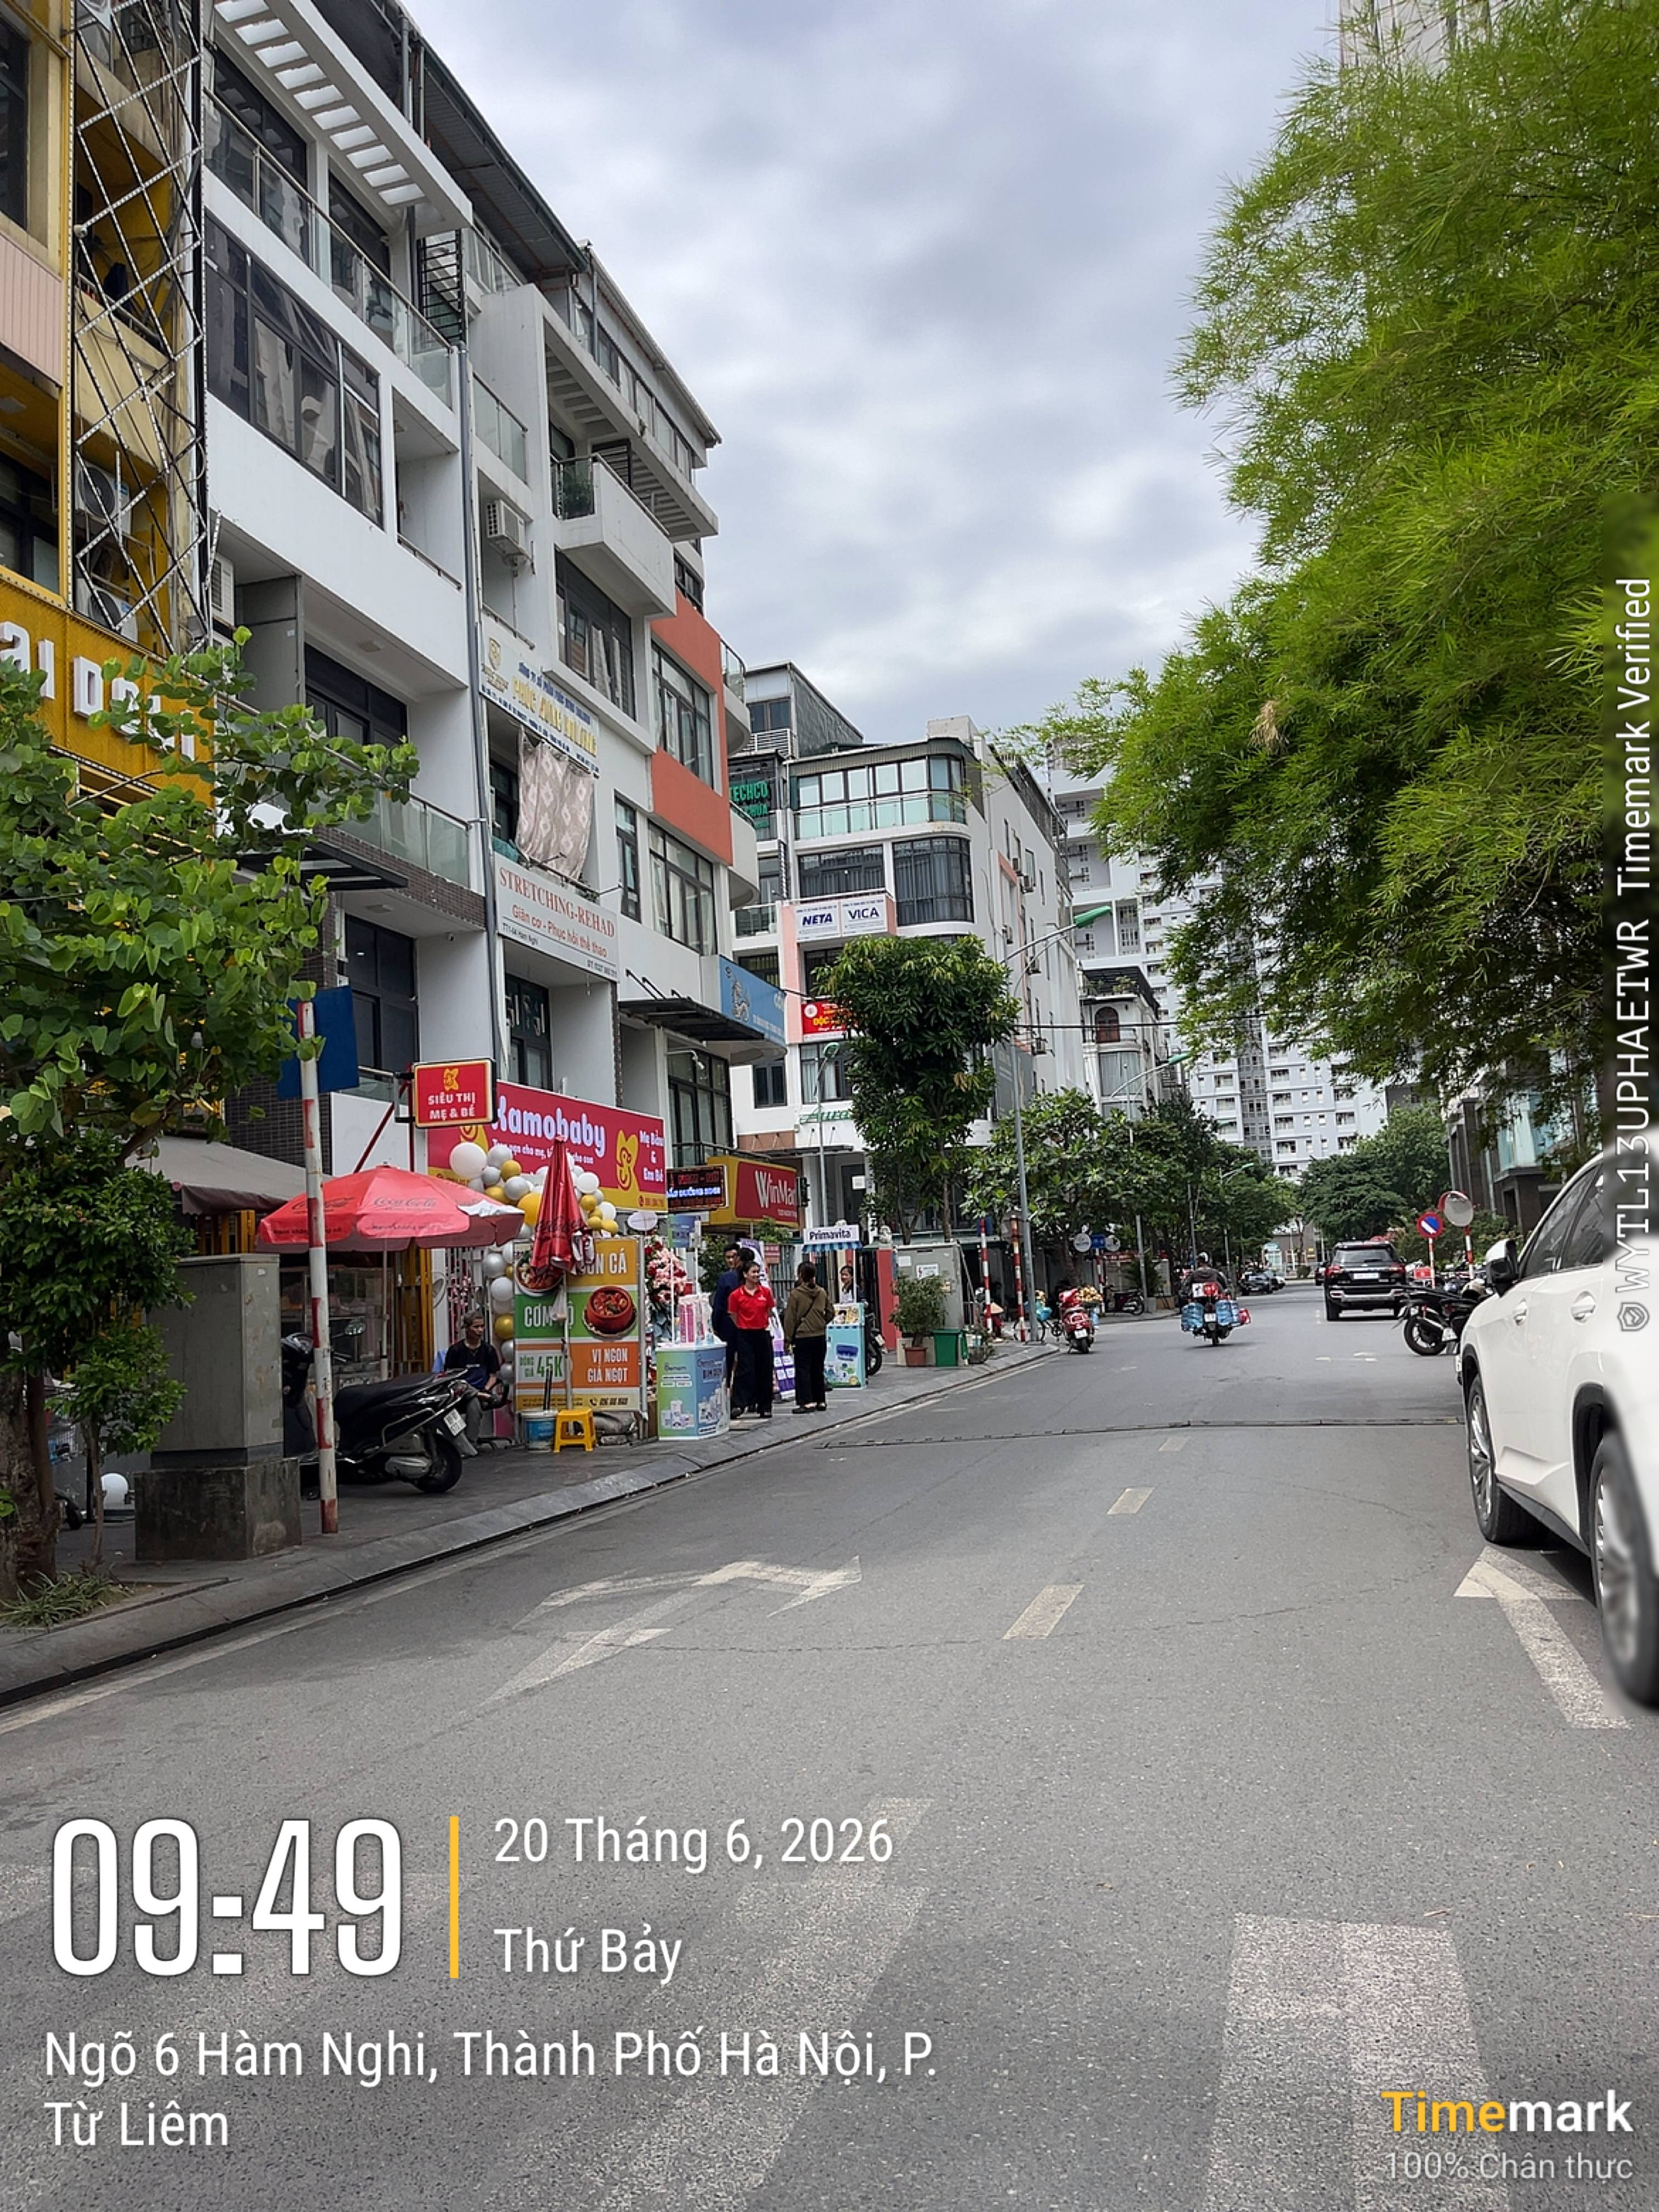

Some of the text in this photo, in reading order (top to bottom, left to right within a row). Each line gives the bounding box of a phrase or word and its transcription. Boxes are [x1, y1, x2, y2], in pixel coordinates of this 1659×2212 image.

[802, 913, 833, 927] NETA
[848, 907, 879, 919] VICA
[428, 1091, 476, 1105] SIÊU THỊ
[429, 1104, 476, 1121] MẸ & BÉ
[755, 1169, 797, 1209] WinMar
[809, 1228, 851, 1240] Primavita
[609, 1248, 627, 1274] CÁ
[592, 1348, 628, 1364] VỊ NGON
[537, 1355, 563, 1378] 45K
[605, 1368, 628, 1384] NGỌT
